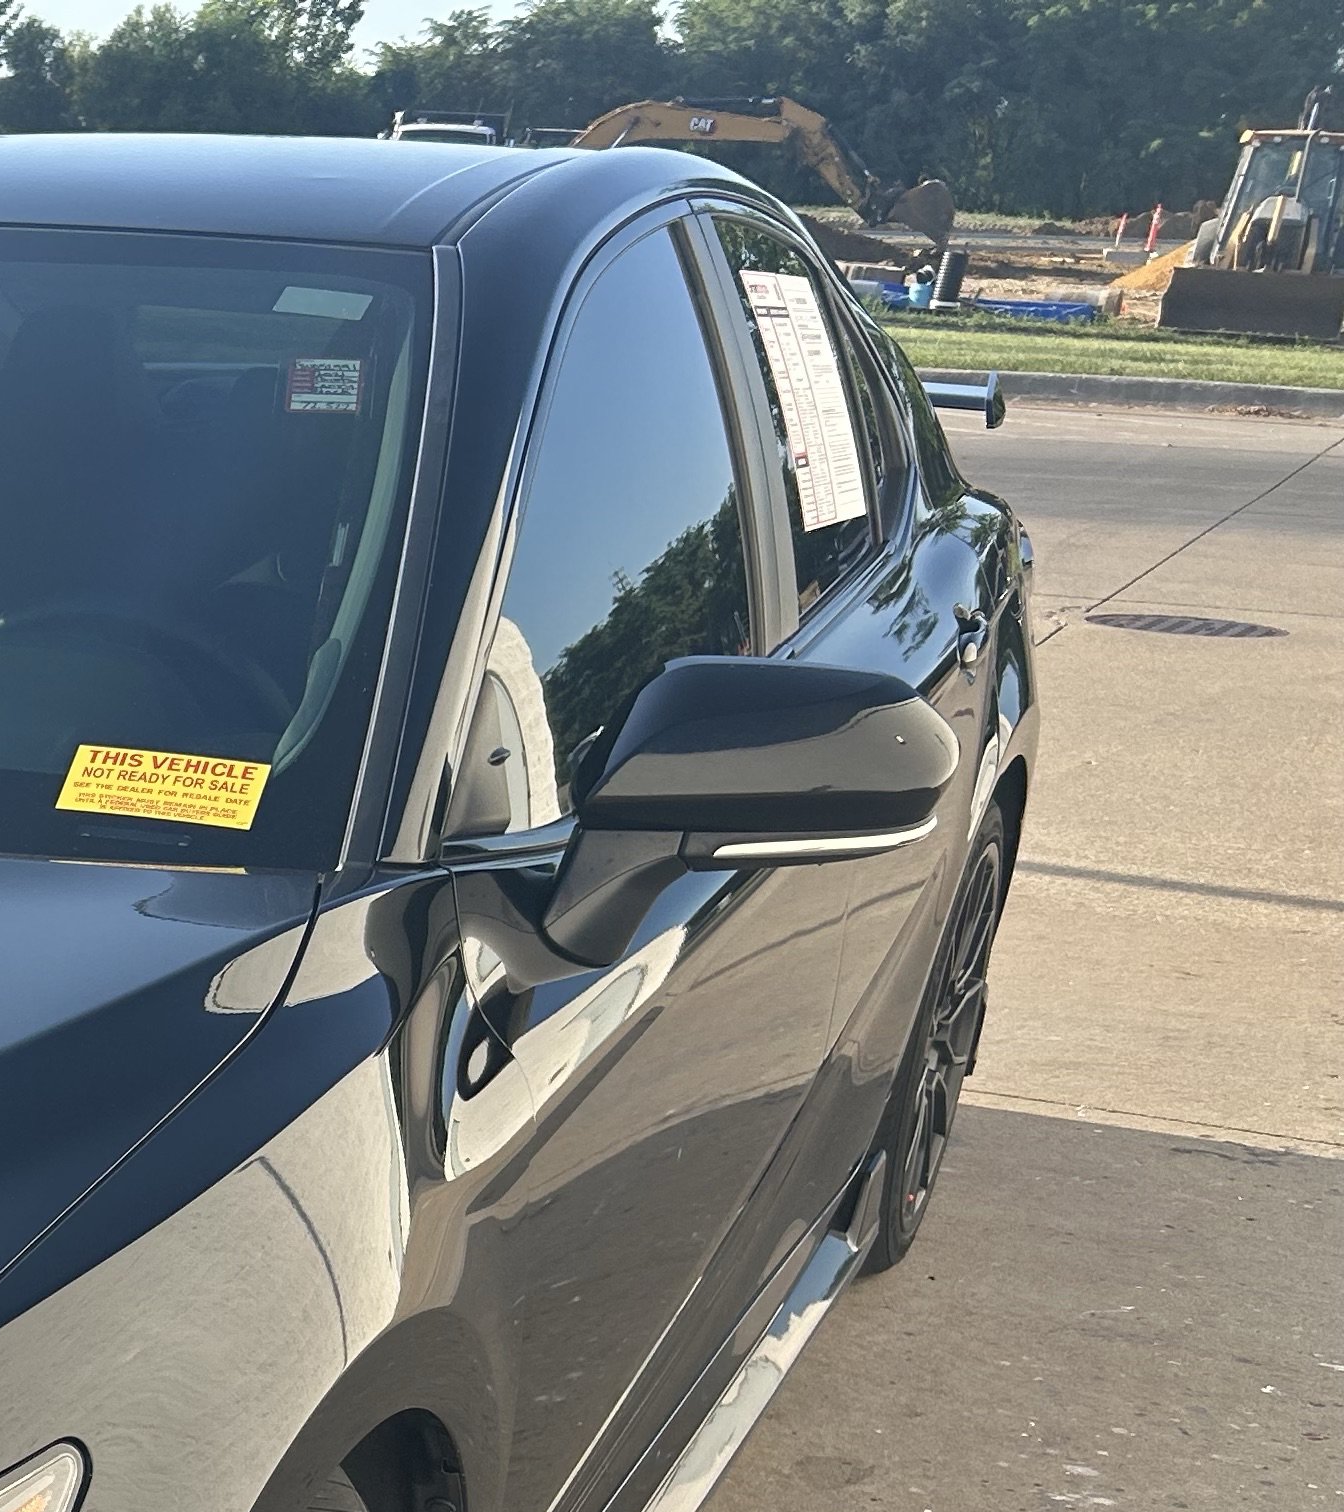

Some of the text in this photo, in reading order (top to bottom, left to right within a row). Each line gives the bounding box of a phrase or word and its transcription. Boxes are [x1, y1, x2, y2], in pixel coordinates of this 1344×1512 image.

[690, 117, 714, 131] CAT
[89, 750, 259, 781] THIS VEHICLE
[73, 781, 92, 789] SEE
[95, 783, 113, 791] THE
[116, 785, 154, 795] DEALER
[157, 789, 178, 798] FOR
[225, 797, 252, 806] DATE
[81, 766, 251, 795] NOT READY FOR SALE
